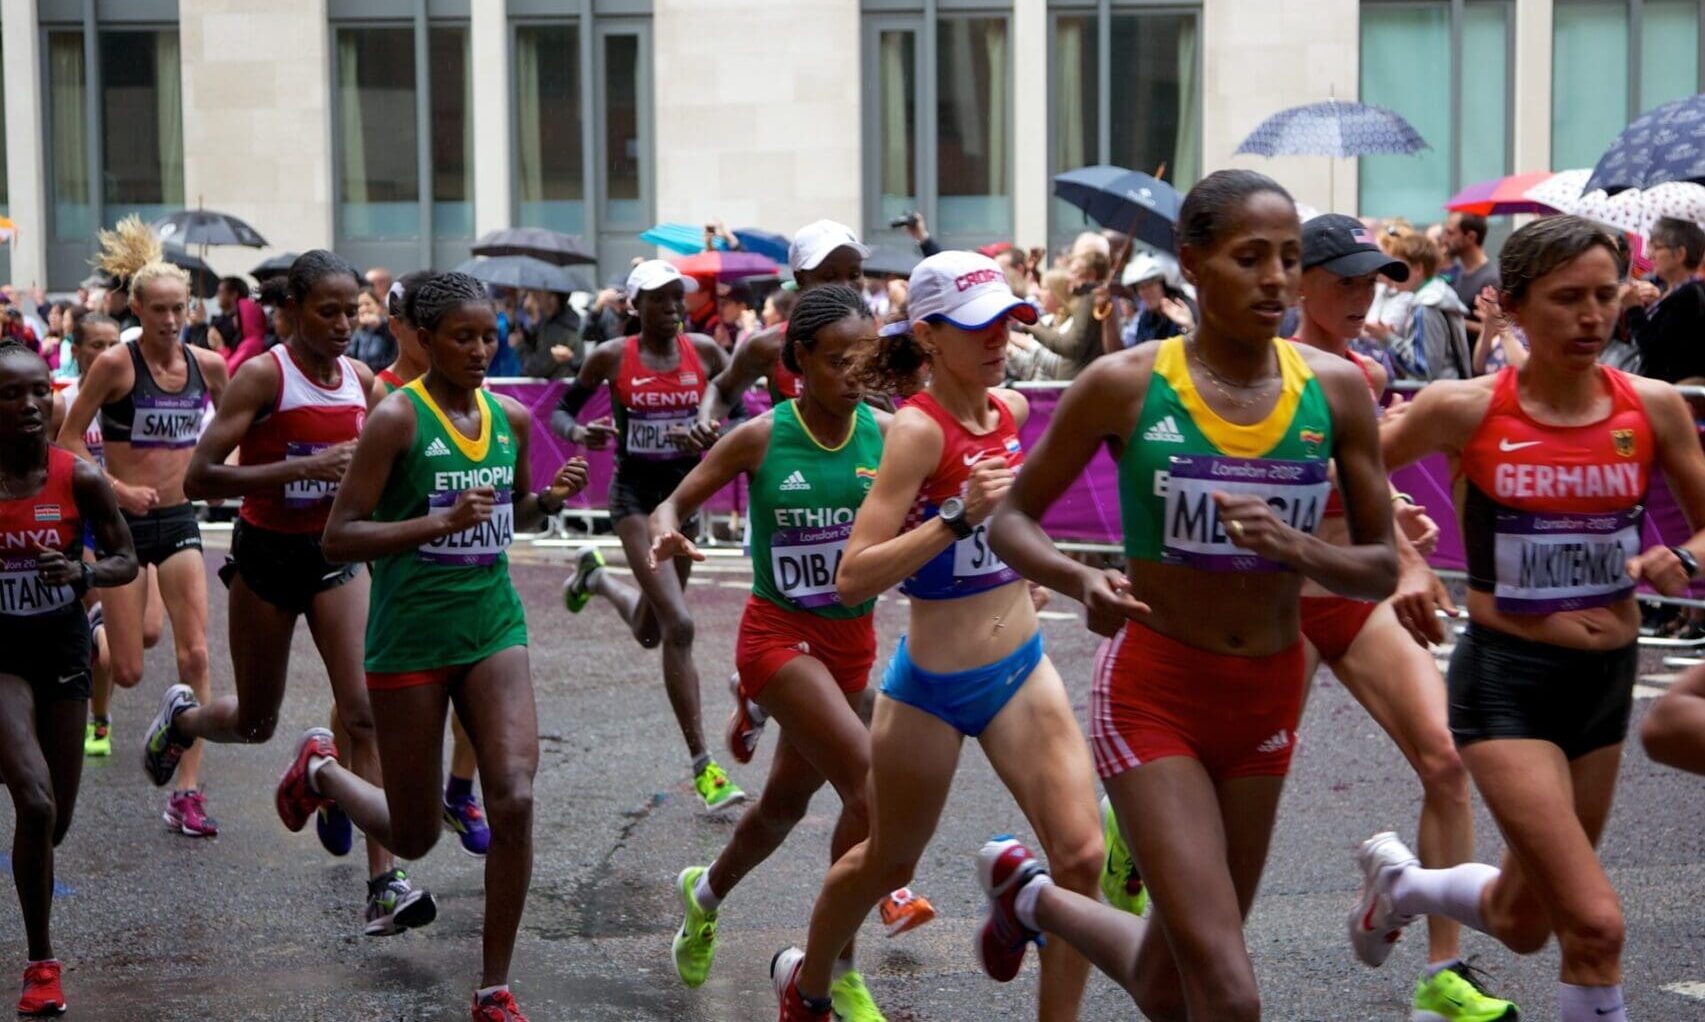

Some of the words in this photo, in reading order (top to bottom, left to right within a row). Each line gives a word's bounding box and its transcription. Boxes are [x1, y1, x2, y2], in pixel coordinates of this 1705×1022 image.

[631, 391, 699, 406] KENYA
[143, 413, 198, 438] SMITH
[435, 466, 514, 490] ETHIOPIA
[1211, 461, 1267, 478] London
[1268, 465, 1304, 480] 2012
[1494, 463, 1641, 498] GERMANY
[1533, 517, 1584, 531] London
[800, 530, 839, 542] London
[1519, 539, 1626, 588] MIKITENKO
